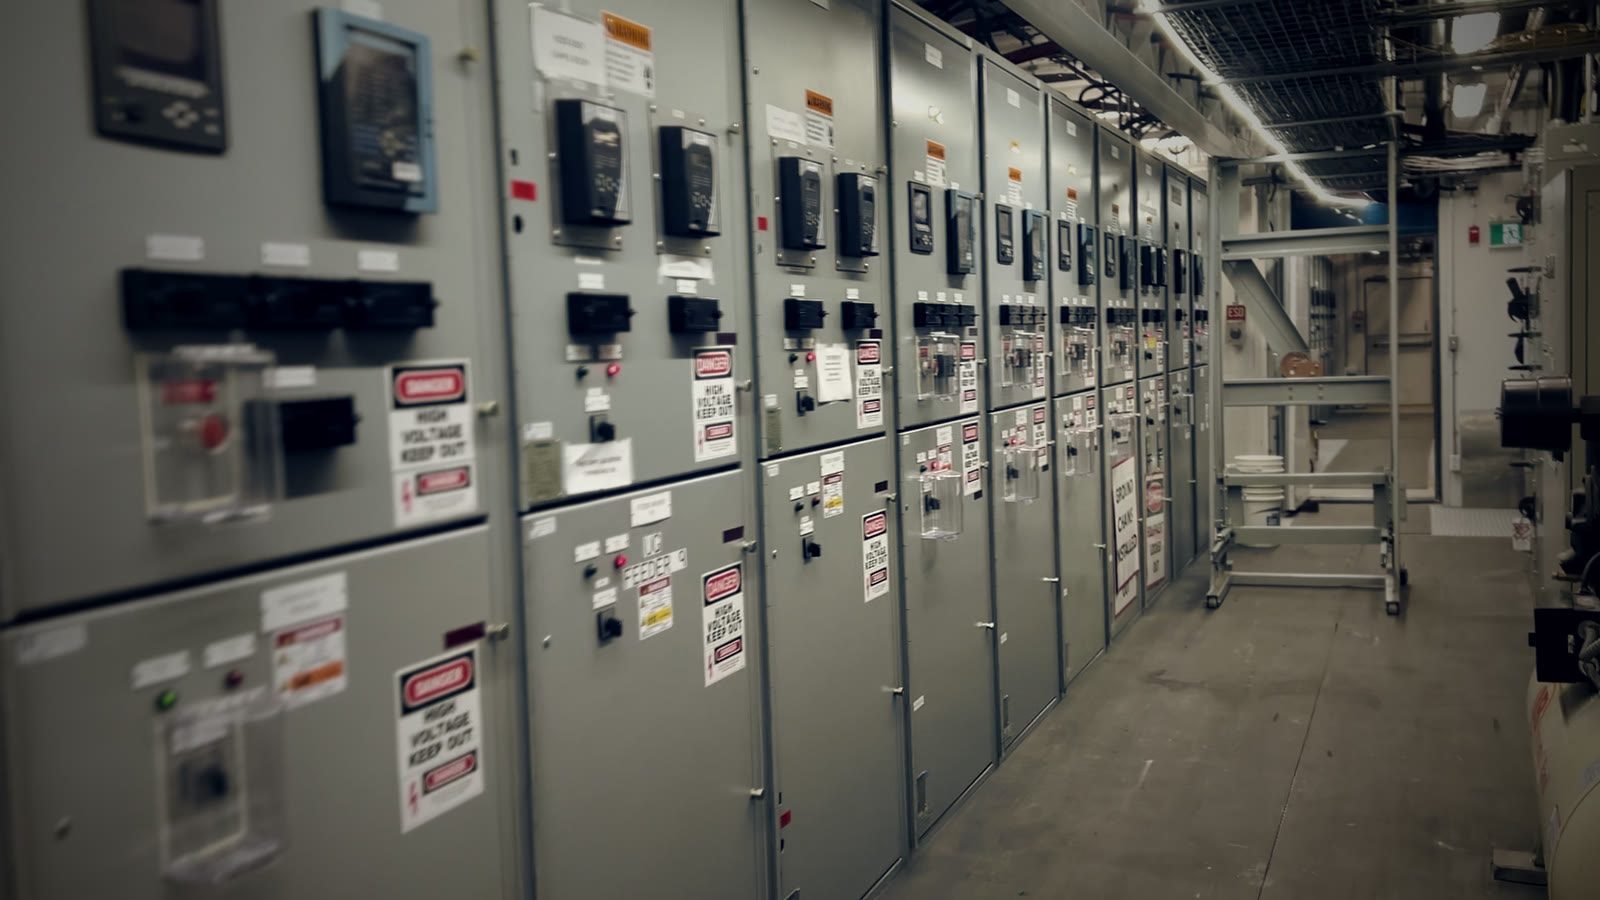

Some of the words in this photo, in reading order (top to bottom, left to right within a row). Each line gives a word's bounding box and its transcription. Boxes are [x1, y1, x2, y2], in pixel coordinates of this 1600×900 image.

[698, 395, 731, 407] VOLTAGE
[705, 385, 723, 395] HIGH
[697, 408, 716, 419] KEEP
[719, 405, 733, 416] OUT
[1116, 534, 1137, 562] NSTALLED
[624, 555, 671, 587] FEEDER
[707, 610, 741, 632] VOLTAGE
[715, 603, 733, 617] HIGH
[707, 628, 726, 643] KEEP
[728, 619, 742, 635] OUT
[412, 711, 470, 747] VOLTAGE
[409, 741, 442, 767] KEEP
[448, 728, 473, 750] OUT
